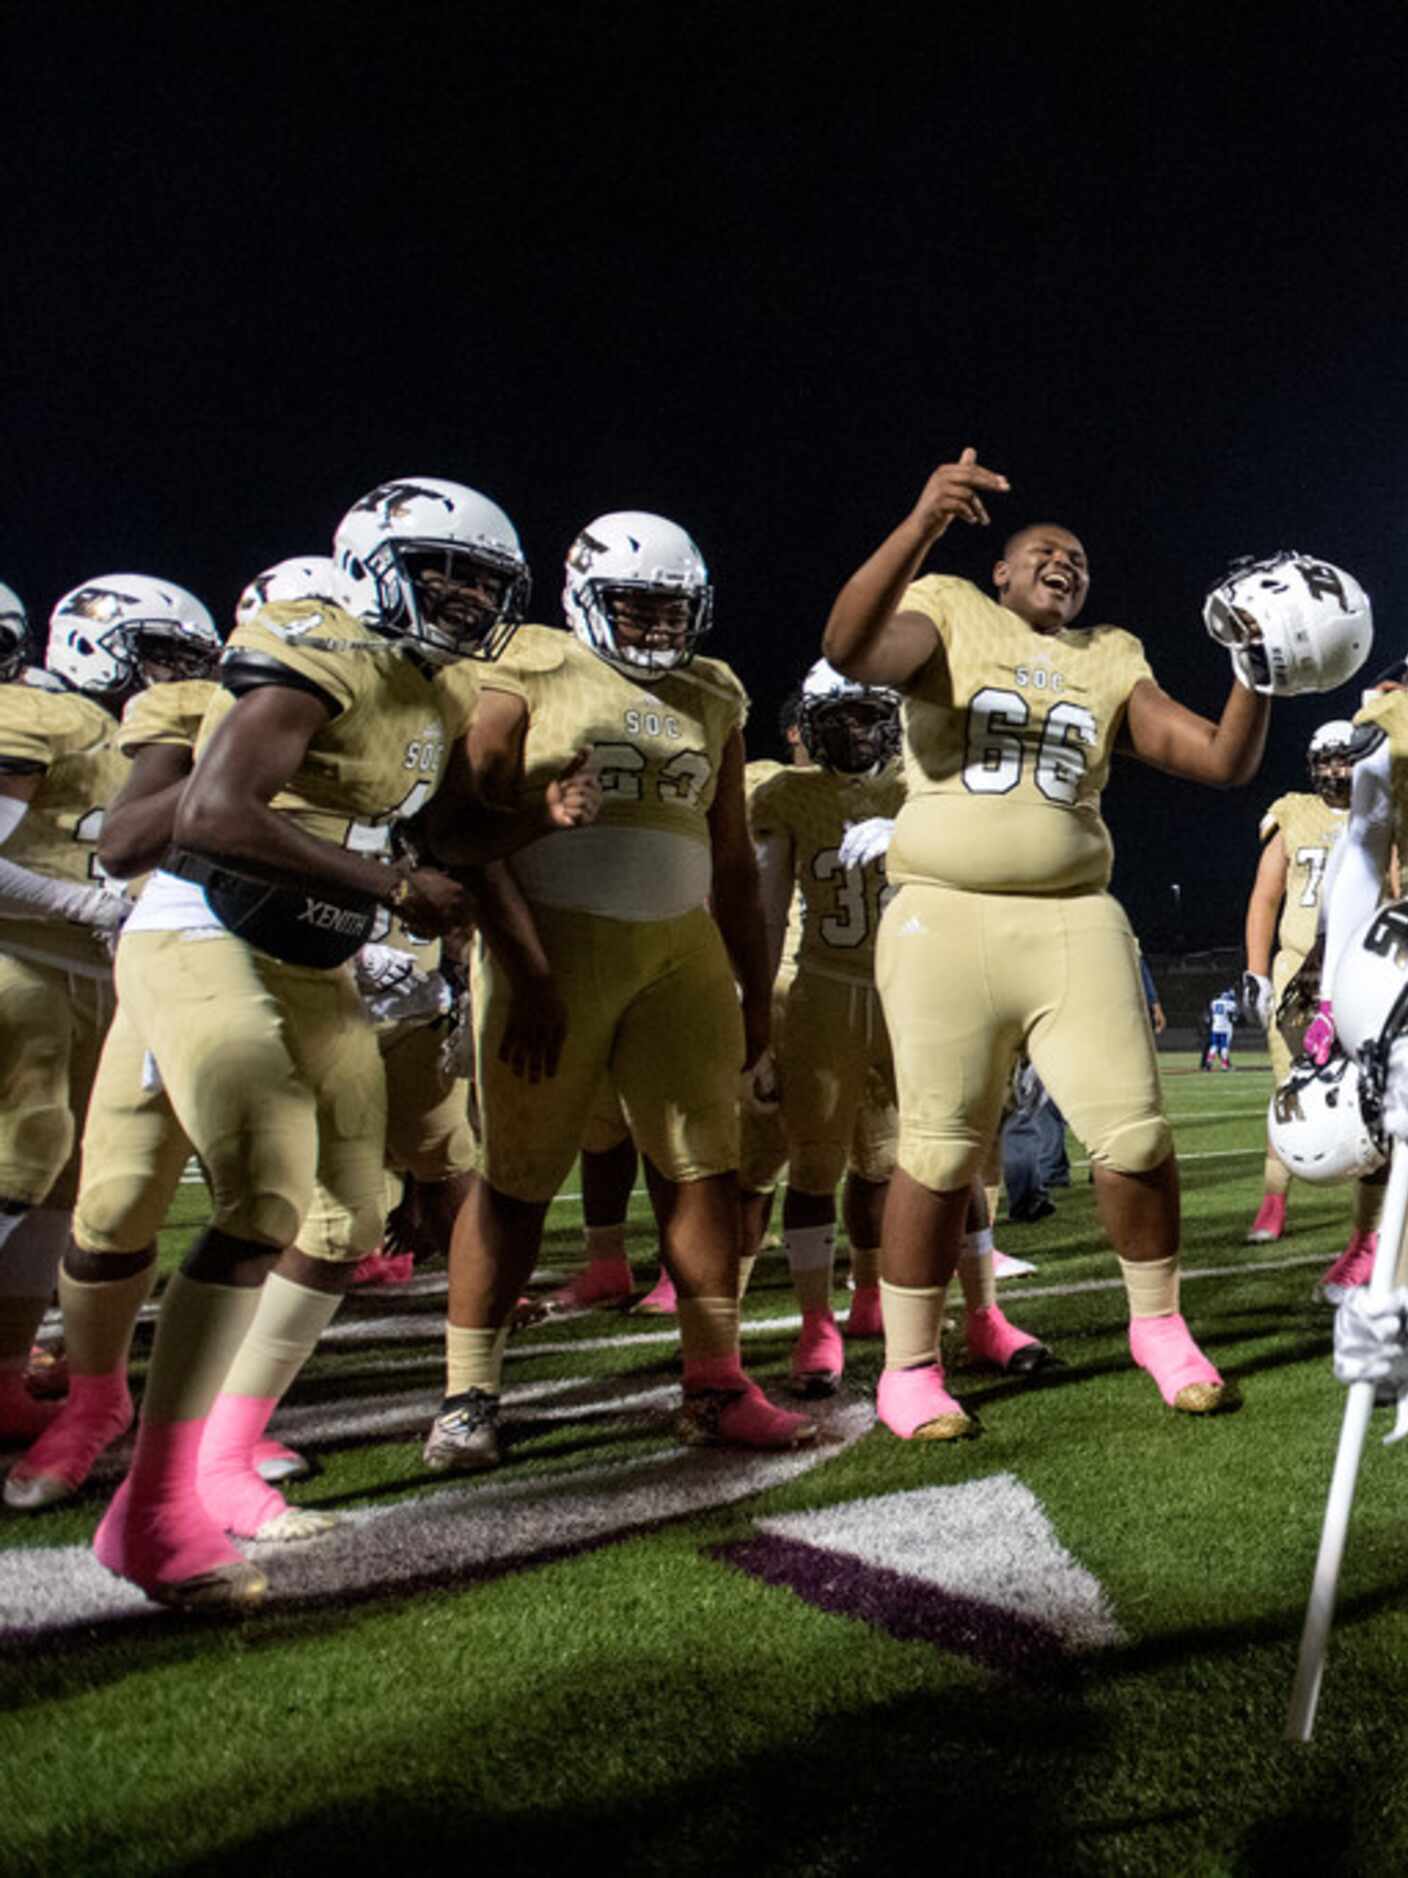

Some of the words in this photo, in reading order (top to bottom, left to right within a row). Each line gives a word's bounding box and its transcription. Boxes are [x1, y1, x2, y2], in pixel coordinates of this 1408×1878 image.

[1014, 664, 1064, 693] SOC
[624, 710, 681, 741] SOC
[961, 687, 1097, 804] 66
[297, 896, 370, 937] XENITH
